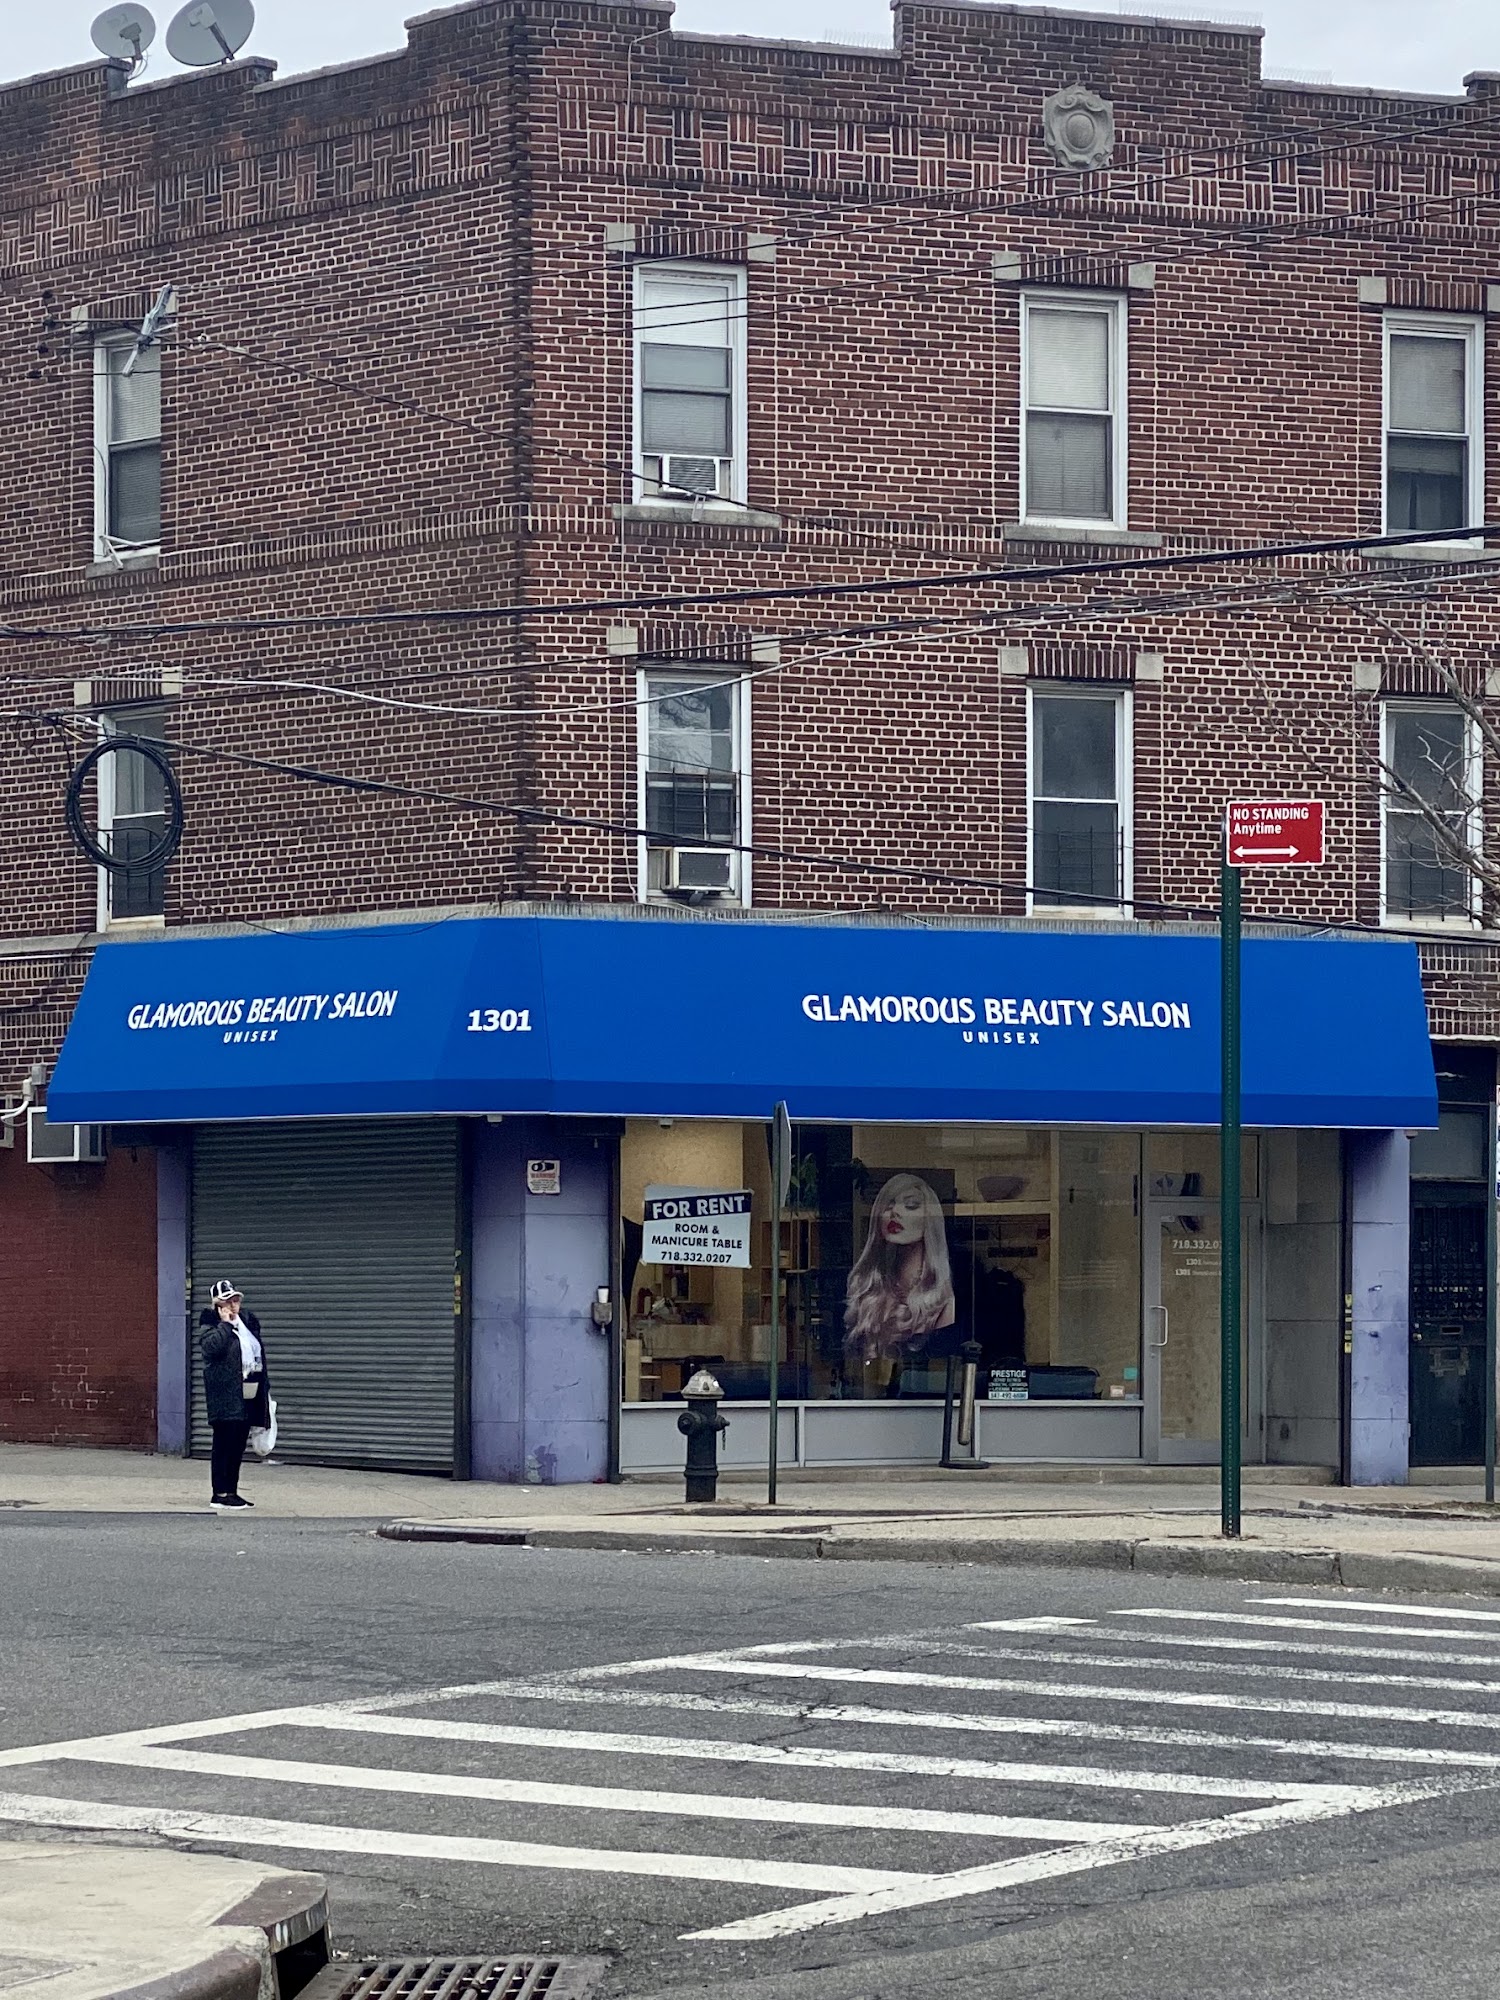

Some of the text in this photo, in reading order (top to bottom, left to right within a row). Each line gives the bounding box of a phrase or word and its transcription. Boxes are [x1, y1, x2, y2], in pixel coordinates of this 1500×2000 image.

[1233, 807, 1309, 820] NO STANDING
[1233, 822, 1282, 837] Anytime
[127, 989, 398, 1030] GLAMOROUS BEAUTY SALON
[801, 994, 1191, 1028] GLAMOROUS BEAUTY SALON
[467, 1009, 532, 1032] 1301
[223, 1029, 278, 1044] UNISEX
[962, 1030, 1040, 1045] UNISEX
[652, 1195, 745, 1220] FOR RENT
[674, 1223, 719, 1234] ROOM &
[651, 1235, 743, 1249] MANICURE TABLE
[1172, 1239, 1221, 1249] 718.332.0
[661, 1251, 732, 1263] 718.332.0207
[991, 1370, 1026, 1378] PRESTIGE
